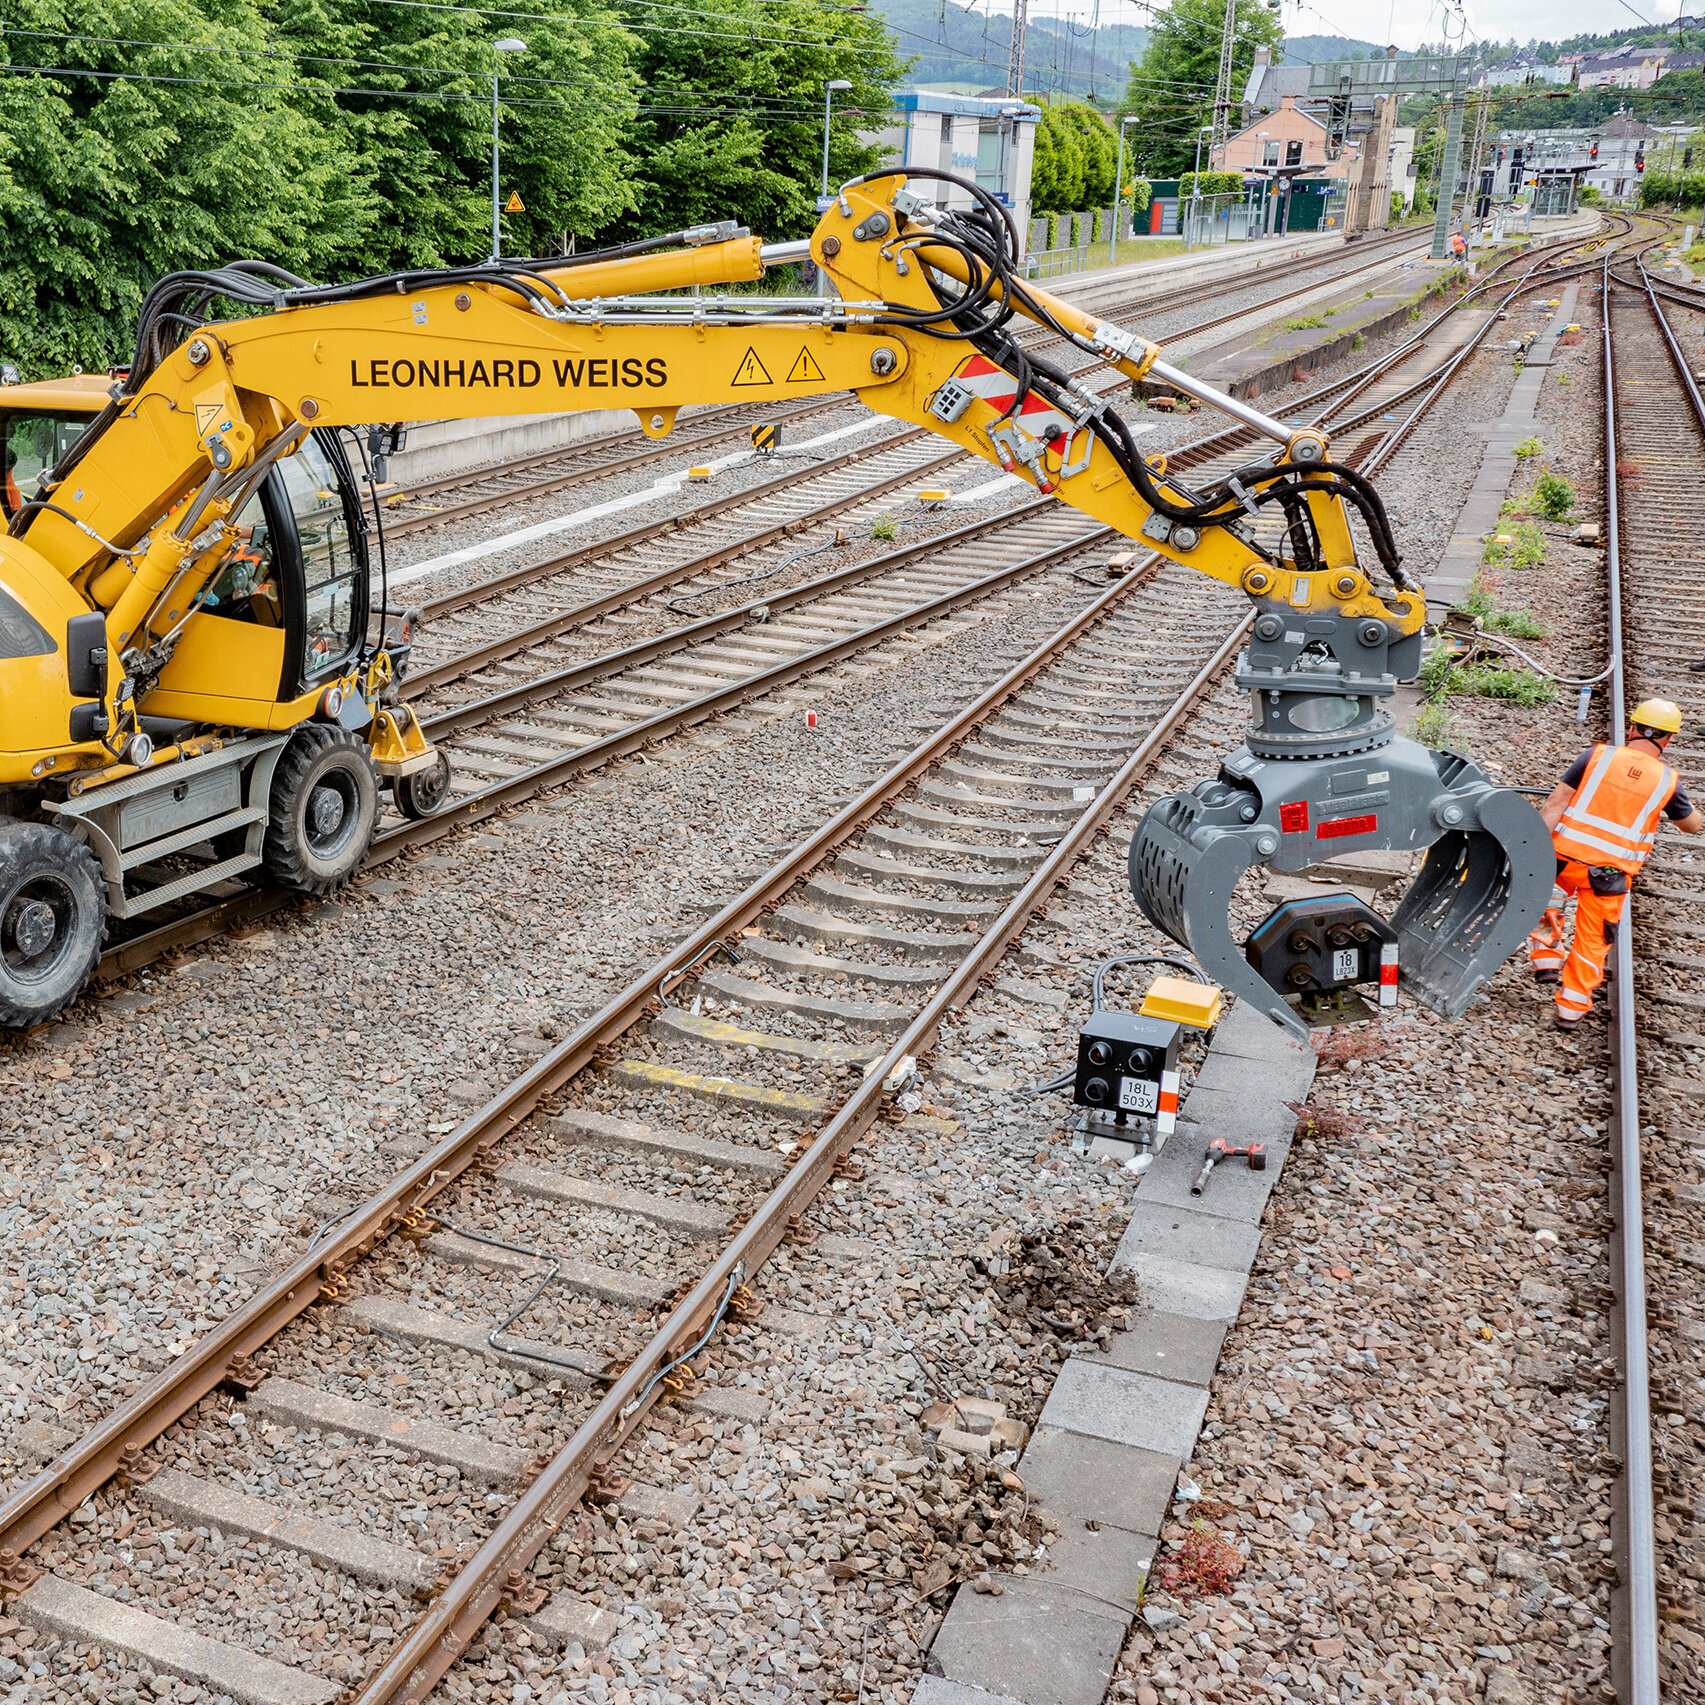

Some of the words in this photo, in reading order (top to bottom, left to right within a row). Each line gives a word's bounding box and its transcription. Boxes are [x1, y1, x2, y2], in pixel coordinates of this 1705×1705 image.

[350, 359, 541, 388] LEONHARD
[552, 358, 668, 388] WEISS
[1340, 954, 1352, 967] 18
[1336, 966, 1356, 976] L823X
[1128, 1081, 1151, 1097] 18L
[1122, 1094, 1154, 1110] 503X
